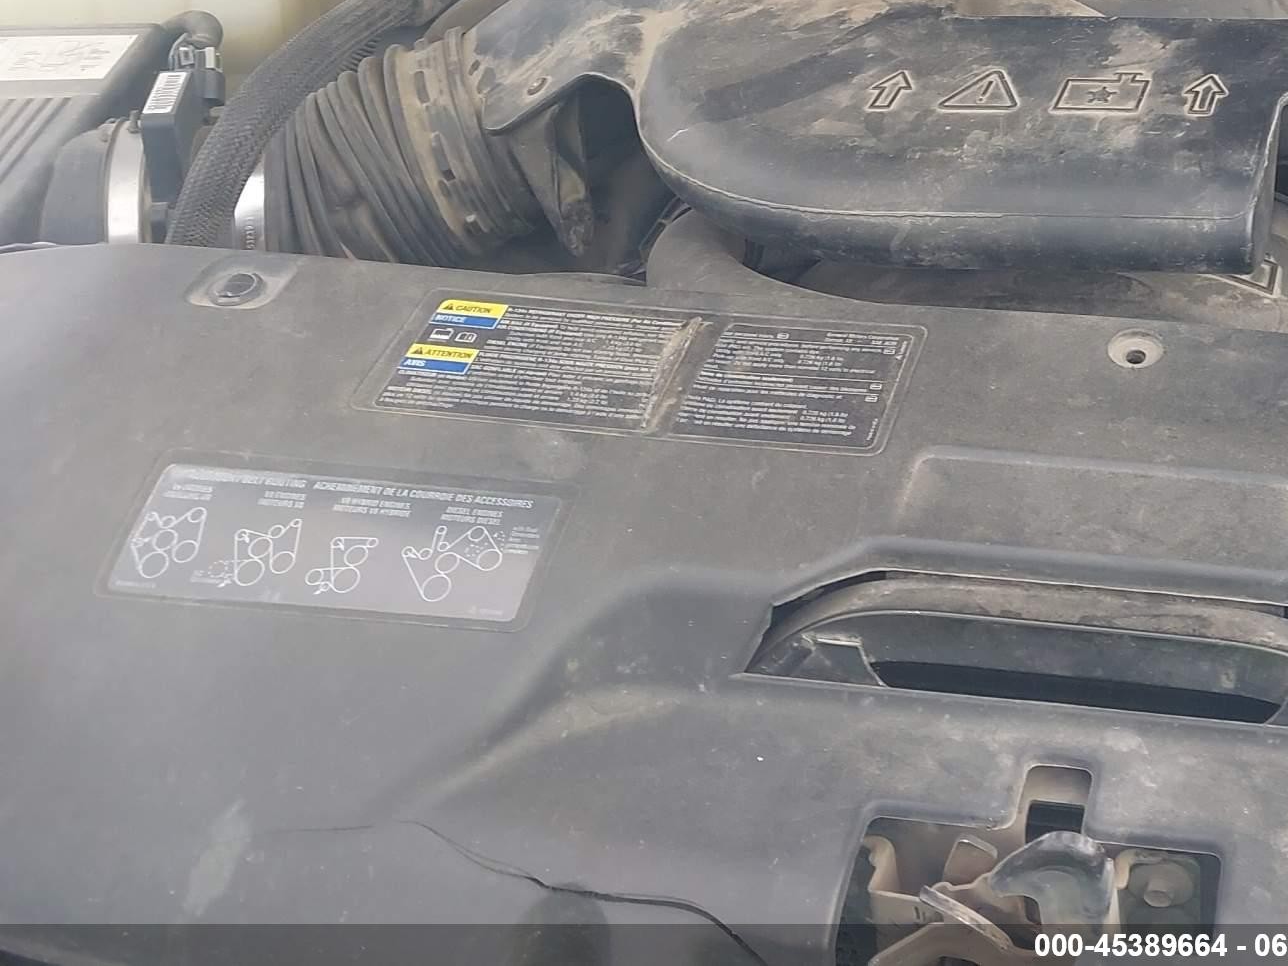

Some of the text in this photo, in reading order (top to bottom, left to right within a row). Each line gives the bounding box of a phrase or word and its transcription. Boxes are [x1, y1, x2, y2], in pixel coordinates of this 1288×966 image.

[455, 304, 492, 314] CAUTION
[434, 314, 467, 323] NOTICE
[425, 349, 473, 359] ATTENTION
